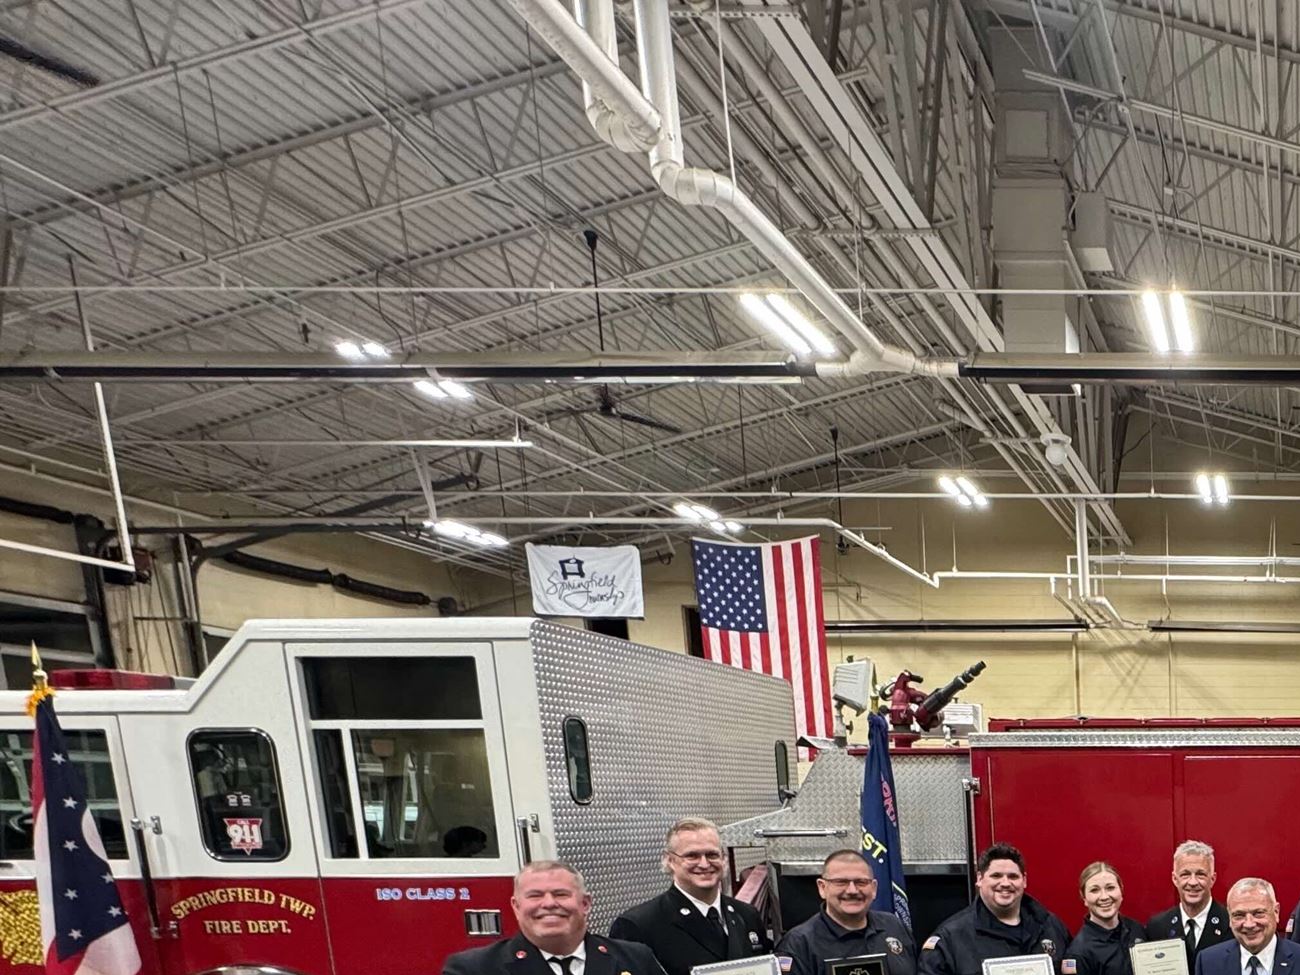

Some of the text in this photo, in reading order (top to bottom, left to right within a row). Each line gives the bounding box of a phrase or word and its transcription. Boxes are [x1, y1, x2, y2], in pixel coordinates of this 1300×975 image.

[226, 824, 262, 844] 911
[376, 887, 471, 901] ISO CLASS 2
[170, 887, 316, 921] SPRINGFIELD TWP.
[203, 920, 292, 934] FIRE DEPT.
